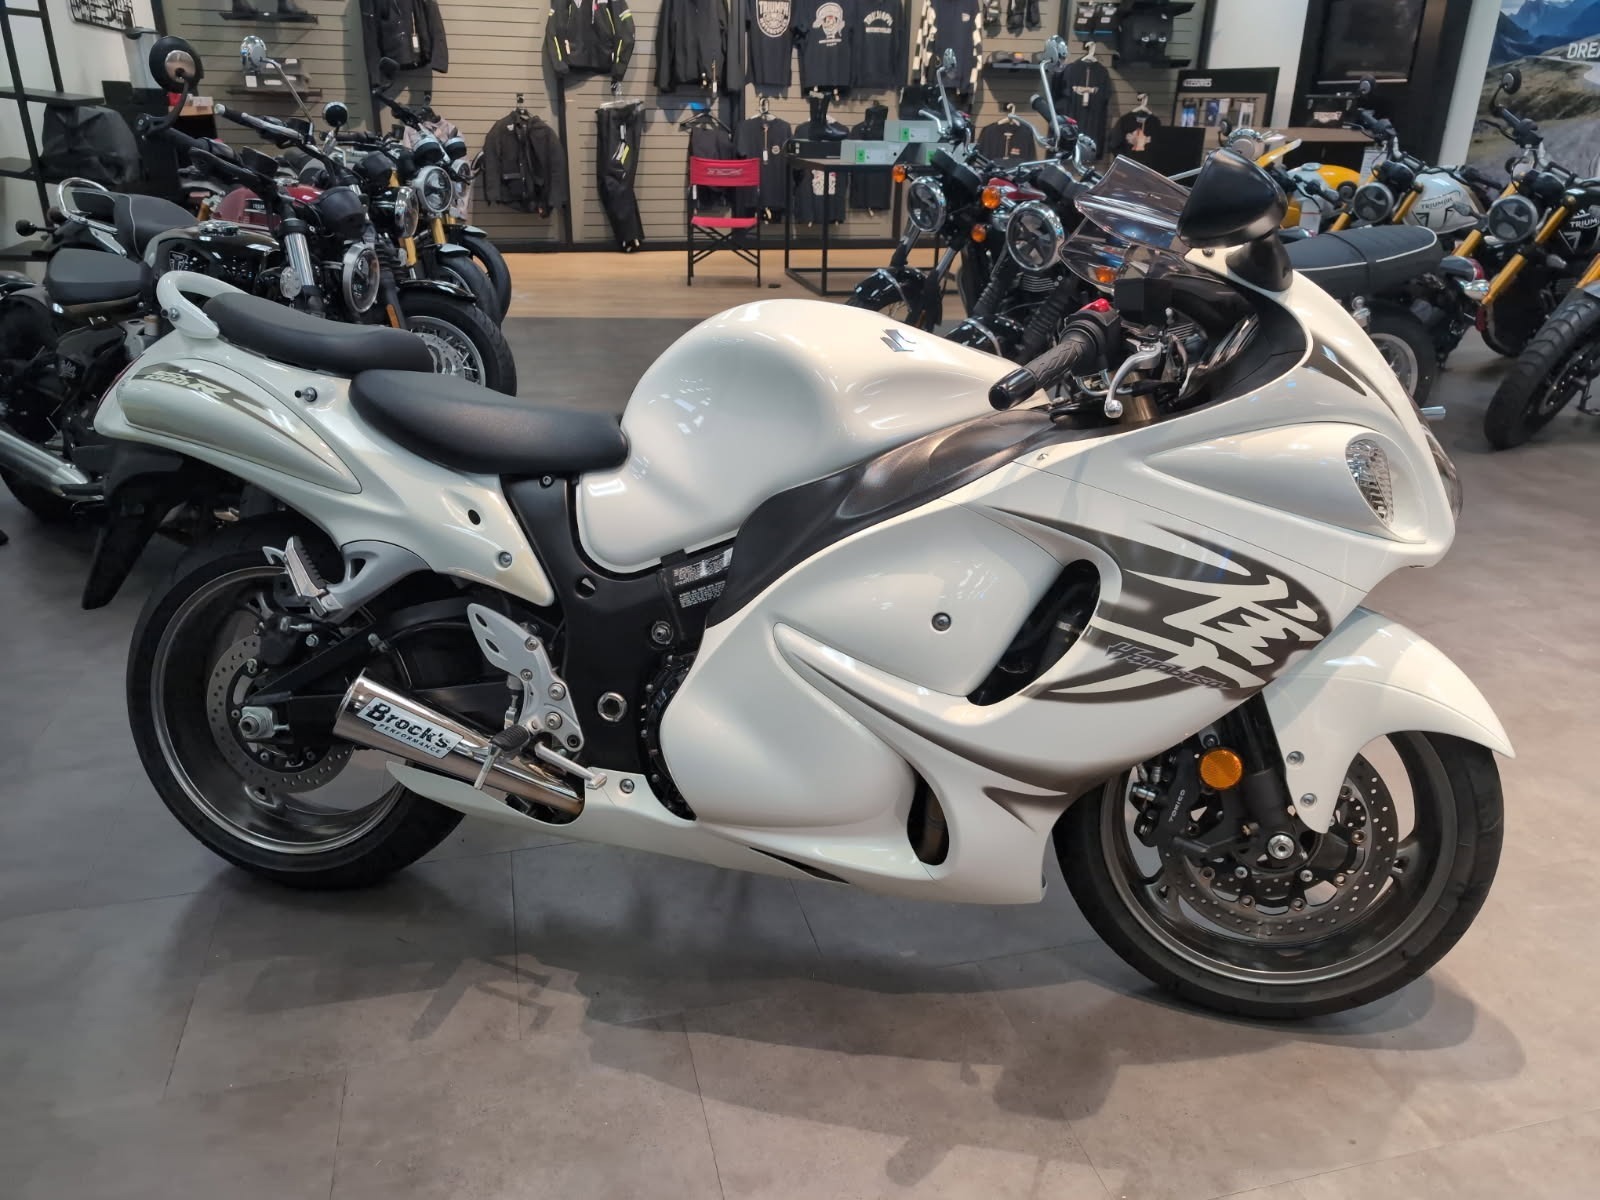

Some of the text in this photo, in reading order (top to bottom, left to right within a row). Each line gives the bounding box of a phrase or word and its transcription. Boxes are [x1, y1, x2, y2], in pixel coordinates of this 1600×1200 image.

[1421, 197, 1454, 209] TRIUMPH
[1570, 217, 1600, 228] TRIUM
[366, 703, 449, 748] Brock's
[378, 723, 442, 753] PERFORMANCE
